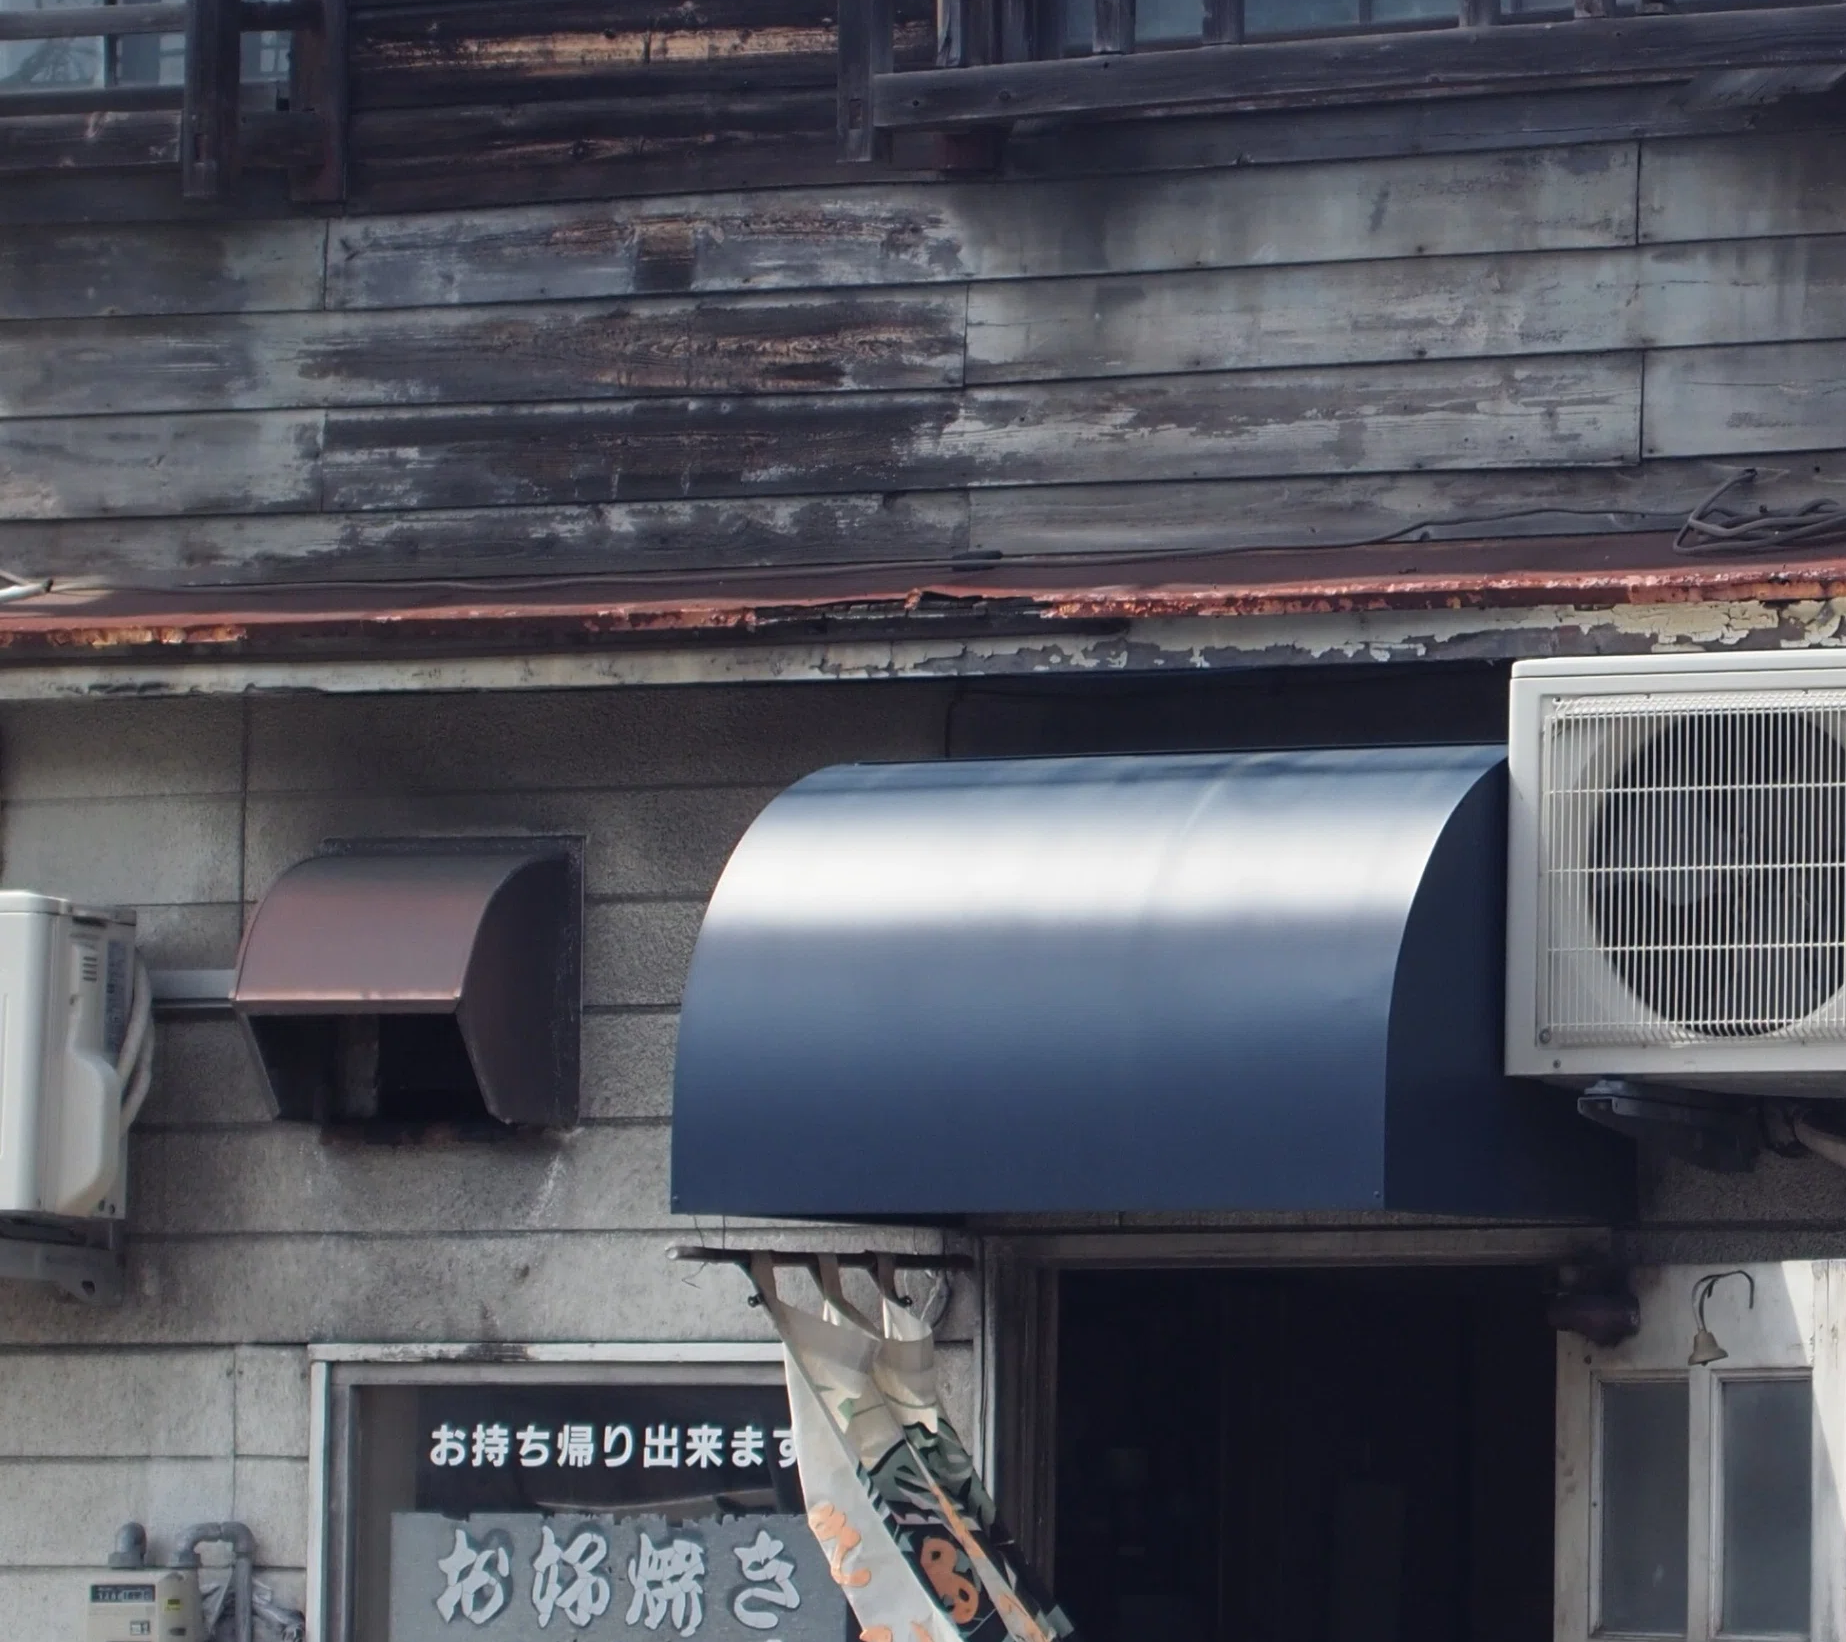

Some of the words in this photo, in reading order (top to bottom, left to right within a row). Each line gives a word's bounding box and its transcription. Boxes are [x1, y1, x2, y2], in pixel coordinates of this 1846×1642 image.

[429, 1423, 799, 1469] お持ち帰り出来ます
[435, 1527, 800, 1636] お好焼き
